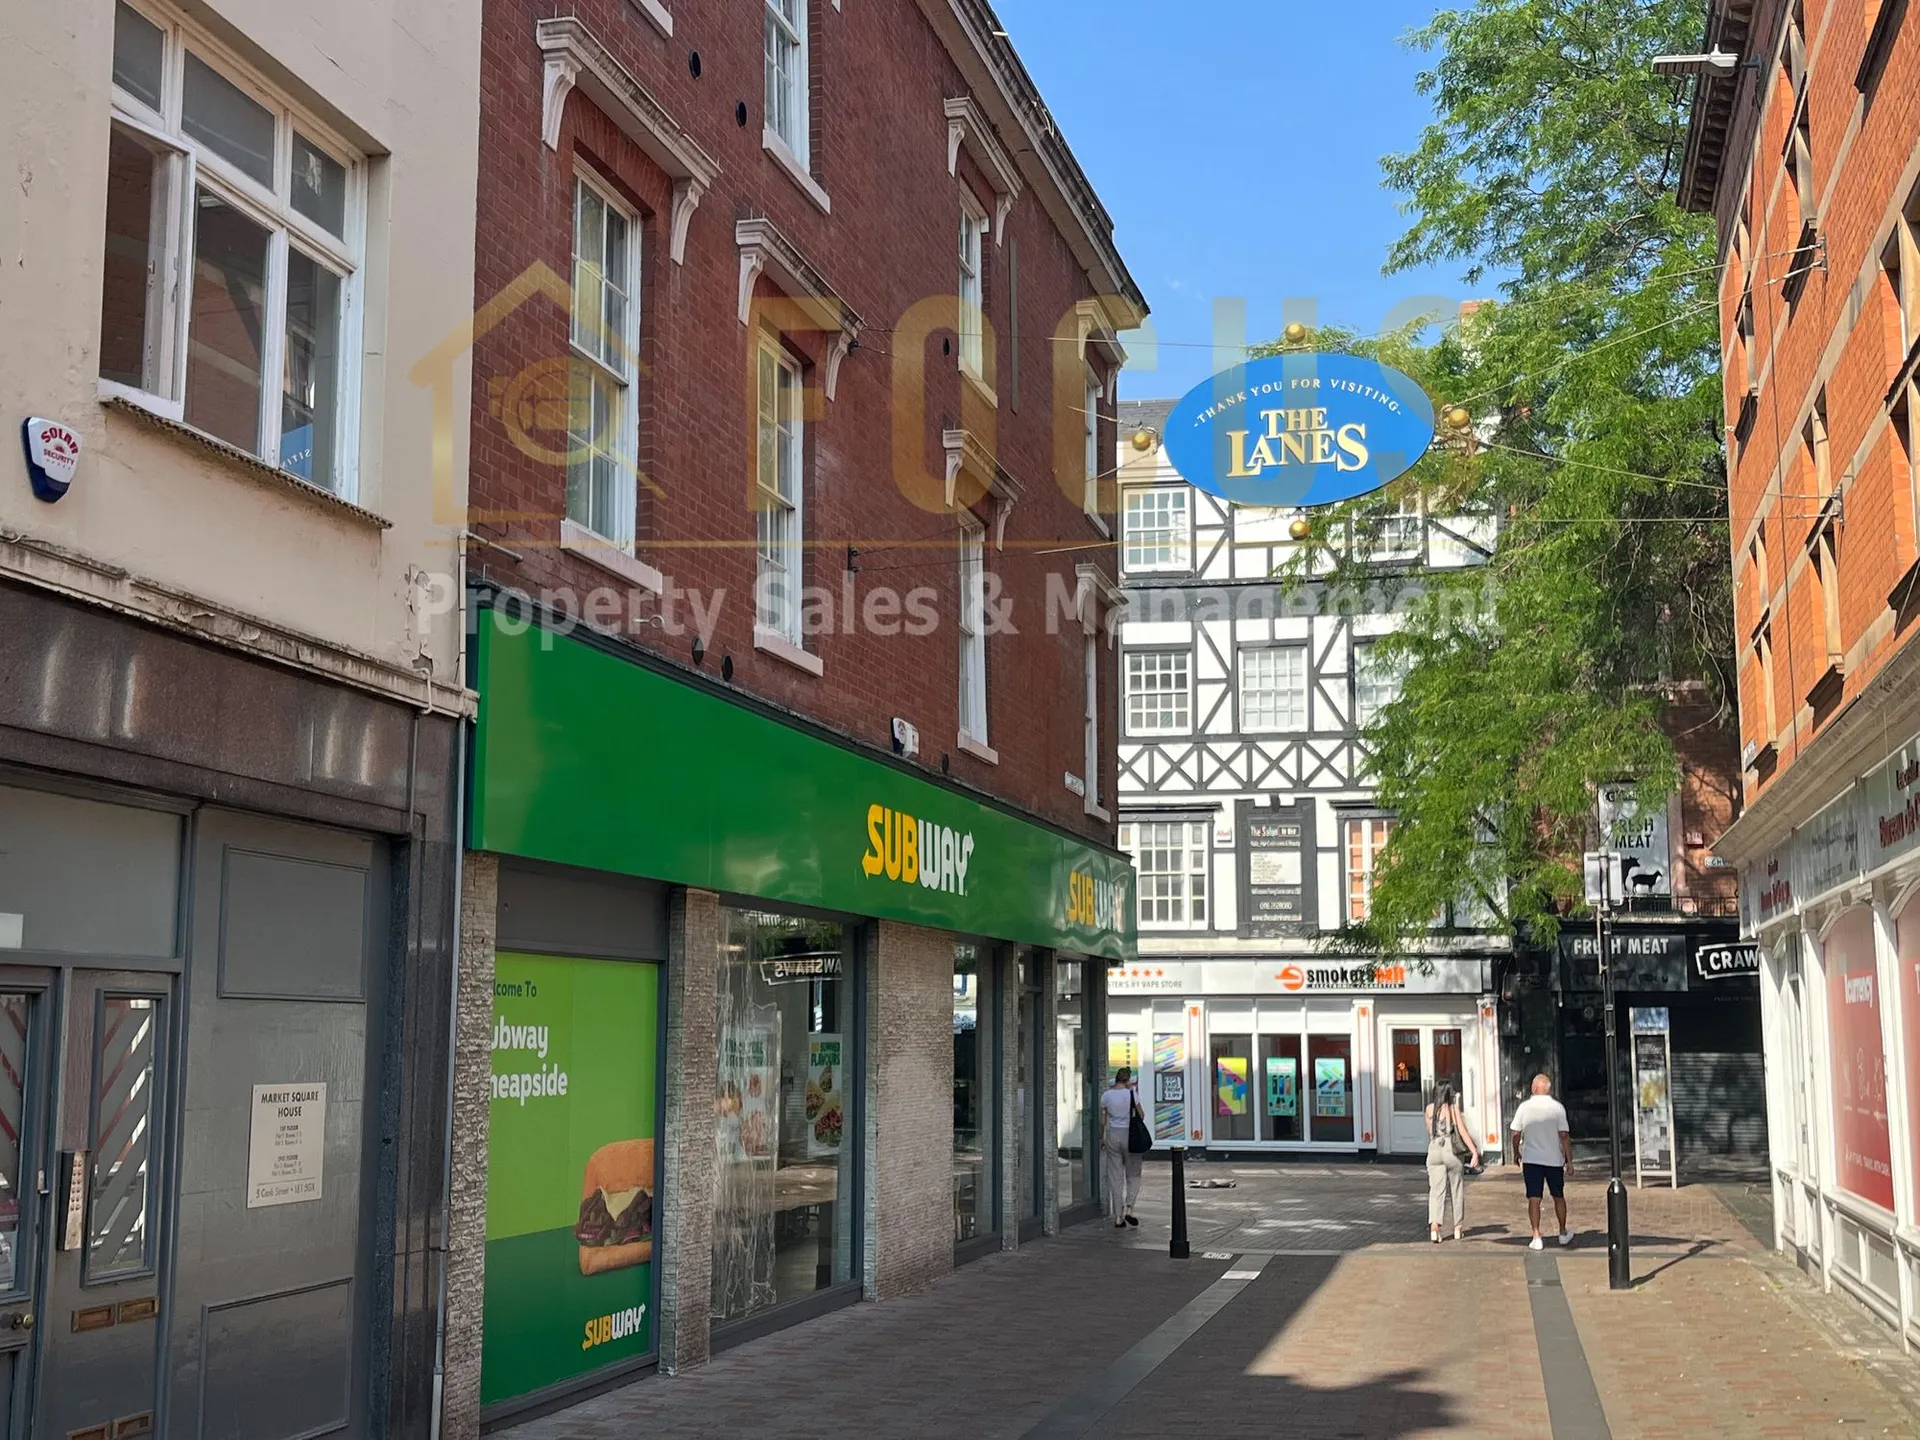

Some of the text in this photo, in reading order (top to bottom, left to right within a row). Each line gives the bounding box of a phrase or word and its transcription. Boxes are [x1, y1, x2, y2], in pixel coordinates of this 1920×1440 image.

[1250, 381, 1284, 398] YOU
[1291, 378, 1321, 390] FOR
[1260, 407, 1328, 439] THE
[1226, 423, 1369, 478] LANES
[862, 803, 975, 897] SUBWAY
[1614, 834, 1651, 849] MEAT
[1573, 937, 1669, 955] FREH MEAT
[524, 980, 537, 997] To
[1161, 980, 1182, 988] STORE
[261, 1091, 319, 1104] MARKET SQUARE
[278, 1106, 302, 1118] HOUSE
[582, 1302, 646, 1352] SUBWAY
